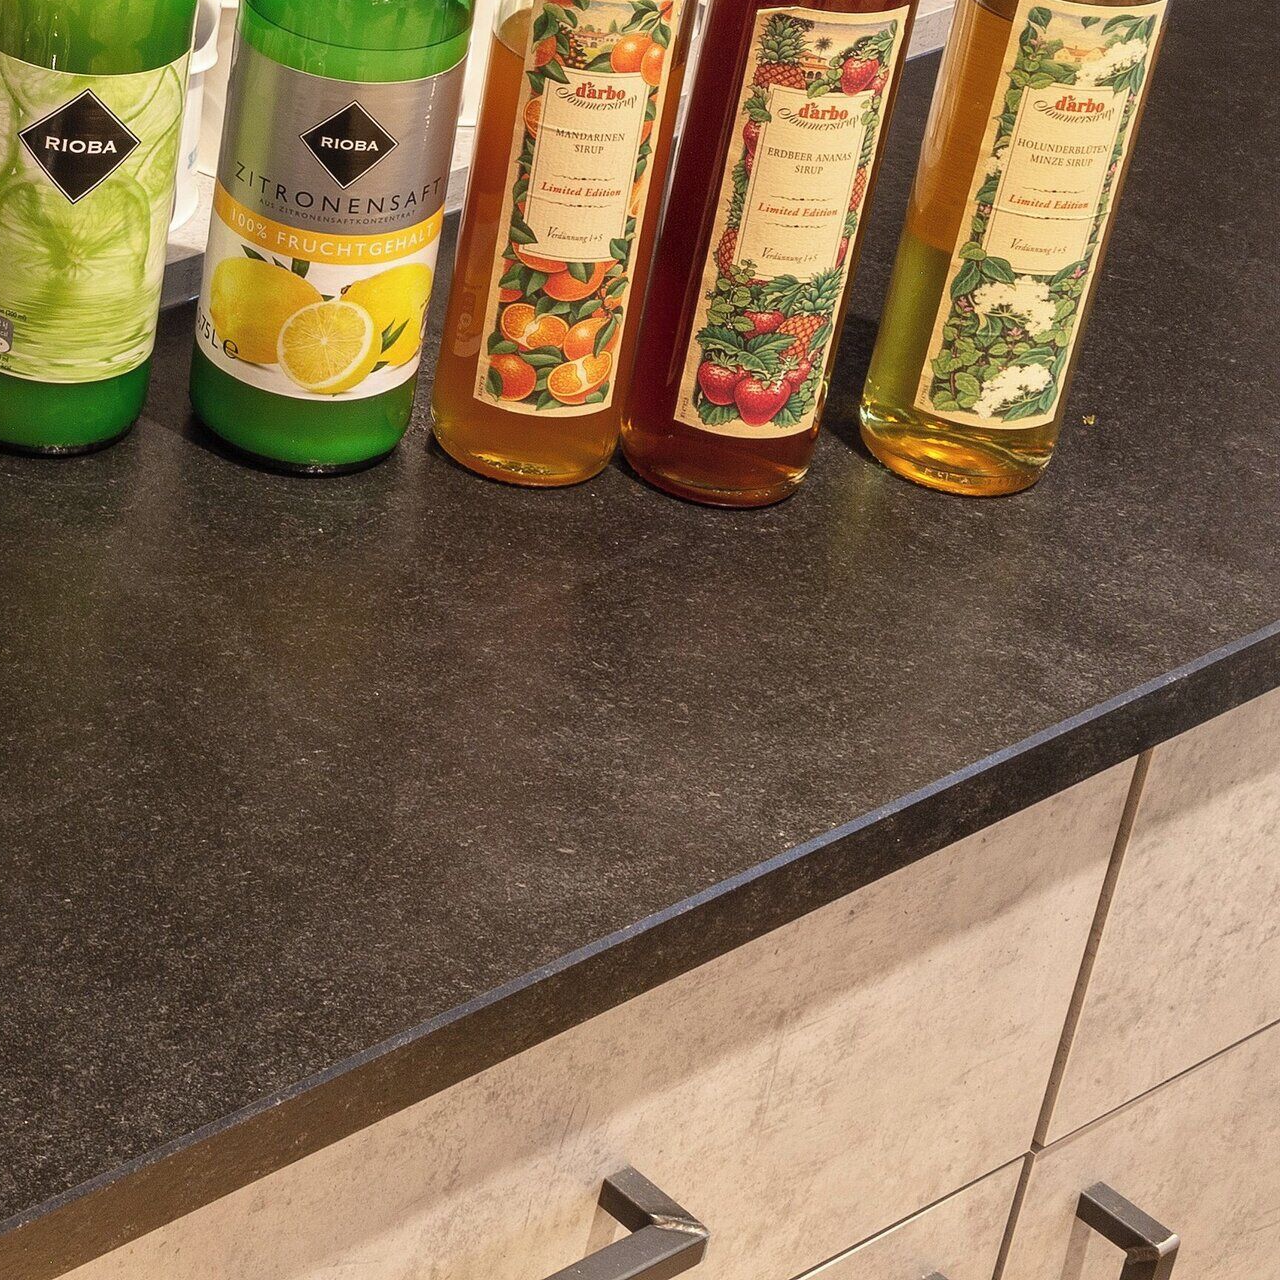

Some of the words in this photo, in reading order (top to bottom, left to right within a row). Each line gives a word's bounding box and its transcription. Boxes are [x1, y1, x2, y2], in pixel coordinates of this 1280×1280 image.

[555, 86, 639, 111] Sommersirup
[776, 107, 860, 132] Sommersirup
[1033, 99, 1116, 125] Sommersirup
[320, 134, 380, 153] RIOBA
[555, 128, 626, 142] MANDARINEN
[44, 135, 119, 155] RIOBA
[574, 144, 605, 155] SIRUP
[767, 146, 813, 162] ERDBEER
[815, 151, 852, 162] ANANAS
[1017, 137, 1110, 156] HOLUNDERBLÜTEN
[794, 164, 824, 175] SIRUP
[1029, 153, 1064, 167] MINZE
[1065, 158, 1094, 168] SIRUP
[234, 160, 443, 215] ZITRONENSAFT
[540, 181, 583, 197] Limited
[584, 186, 622, 198] Edition
[258, 197, 276, 209] AUS
[758, 202, 800, 217] Limited
[802, 208, 838, 218] Edition
[1008, 193, 1052, 210] Limited
[1053, 200, 1089, 211] Edition
[228, 207, 268, 240] 100%
[276, 220, 435, 258] FRUCHTGEHALT
[546, 226, 589, 244] Verdünnung
[761, 246, 803, 264] Verdünnung
[1009, 237, 1052, 256] Verdünnung
